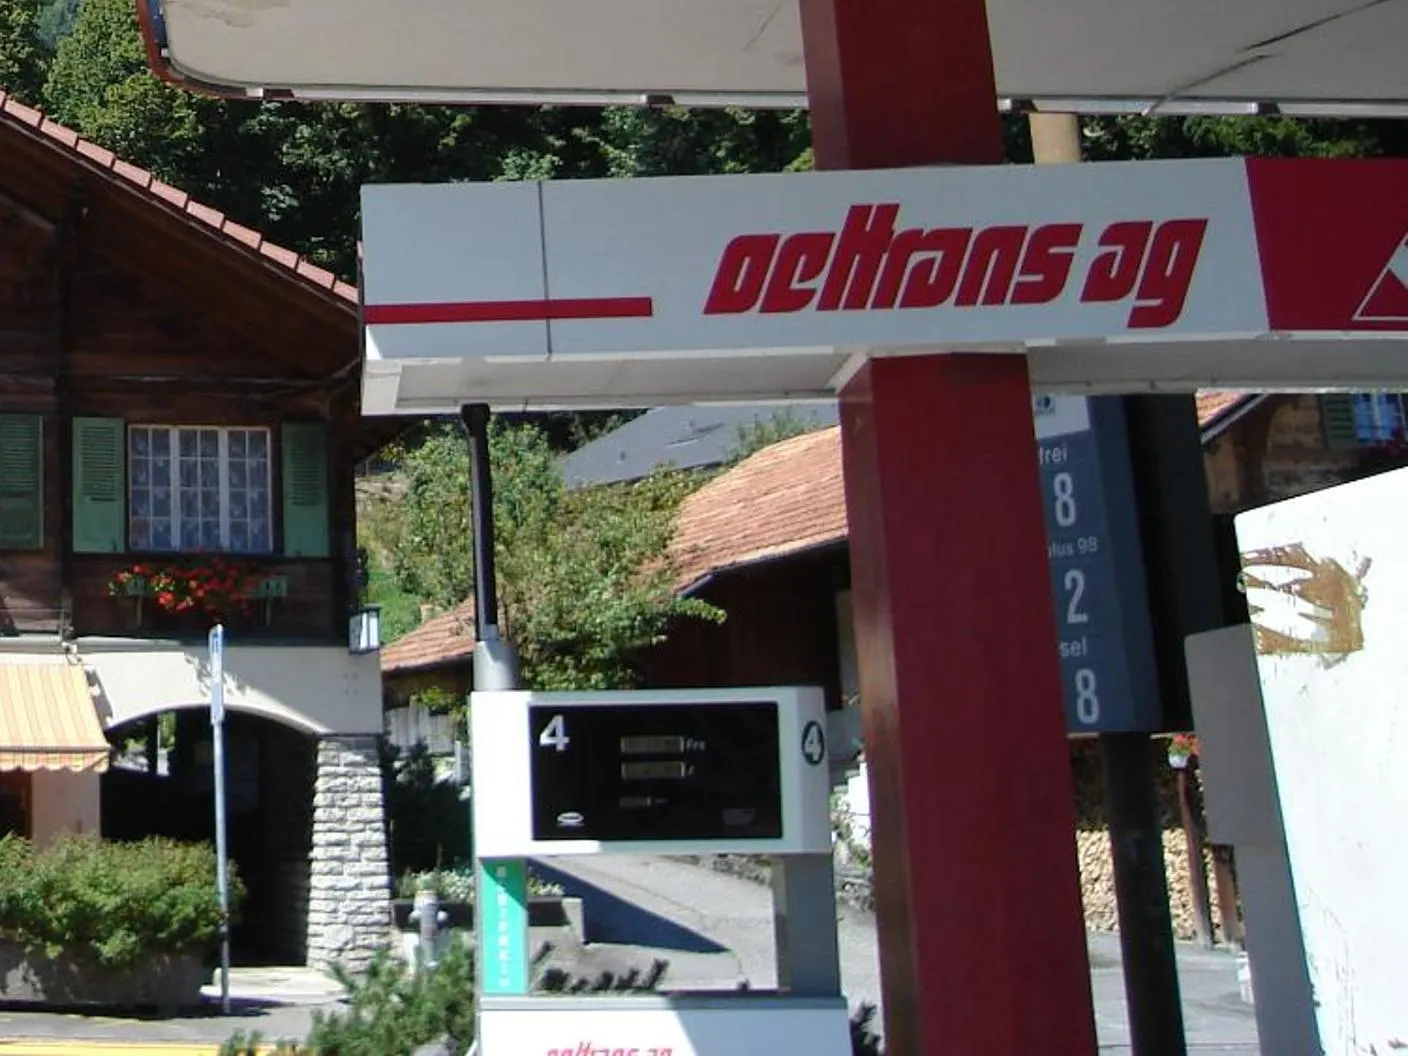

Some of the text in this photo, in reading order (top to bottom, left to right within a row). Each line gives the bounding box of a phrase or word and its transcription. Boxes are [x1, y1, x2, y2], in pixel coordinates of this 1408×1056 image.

[1080, 218, 1208, 329] ag
[1053, 472, 1076, 527] 8
[1064, 569, 1089, 625] 2
[1075, 668, 1100, 724] 8
[540, 714, 571, 752] 4
[805, 724, 822, 761] 4
